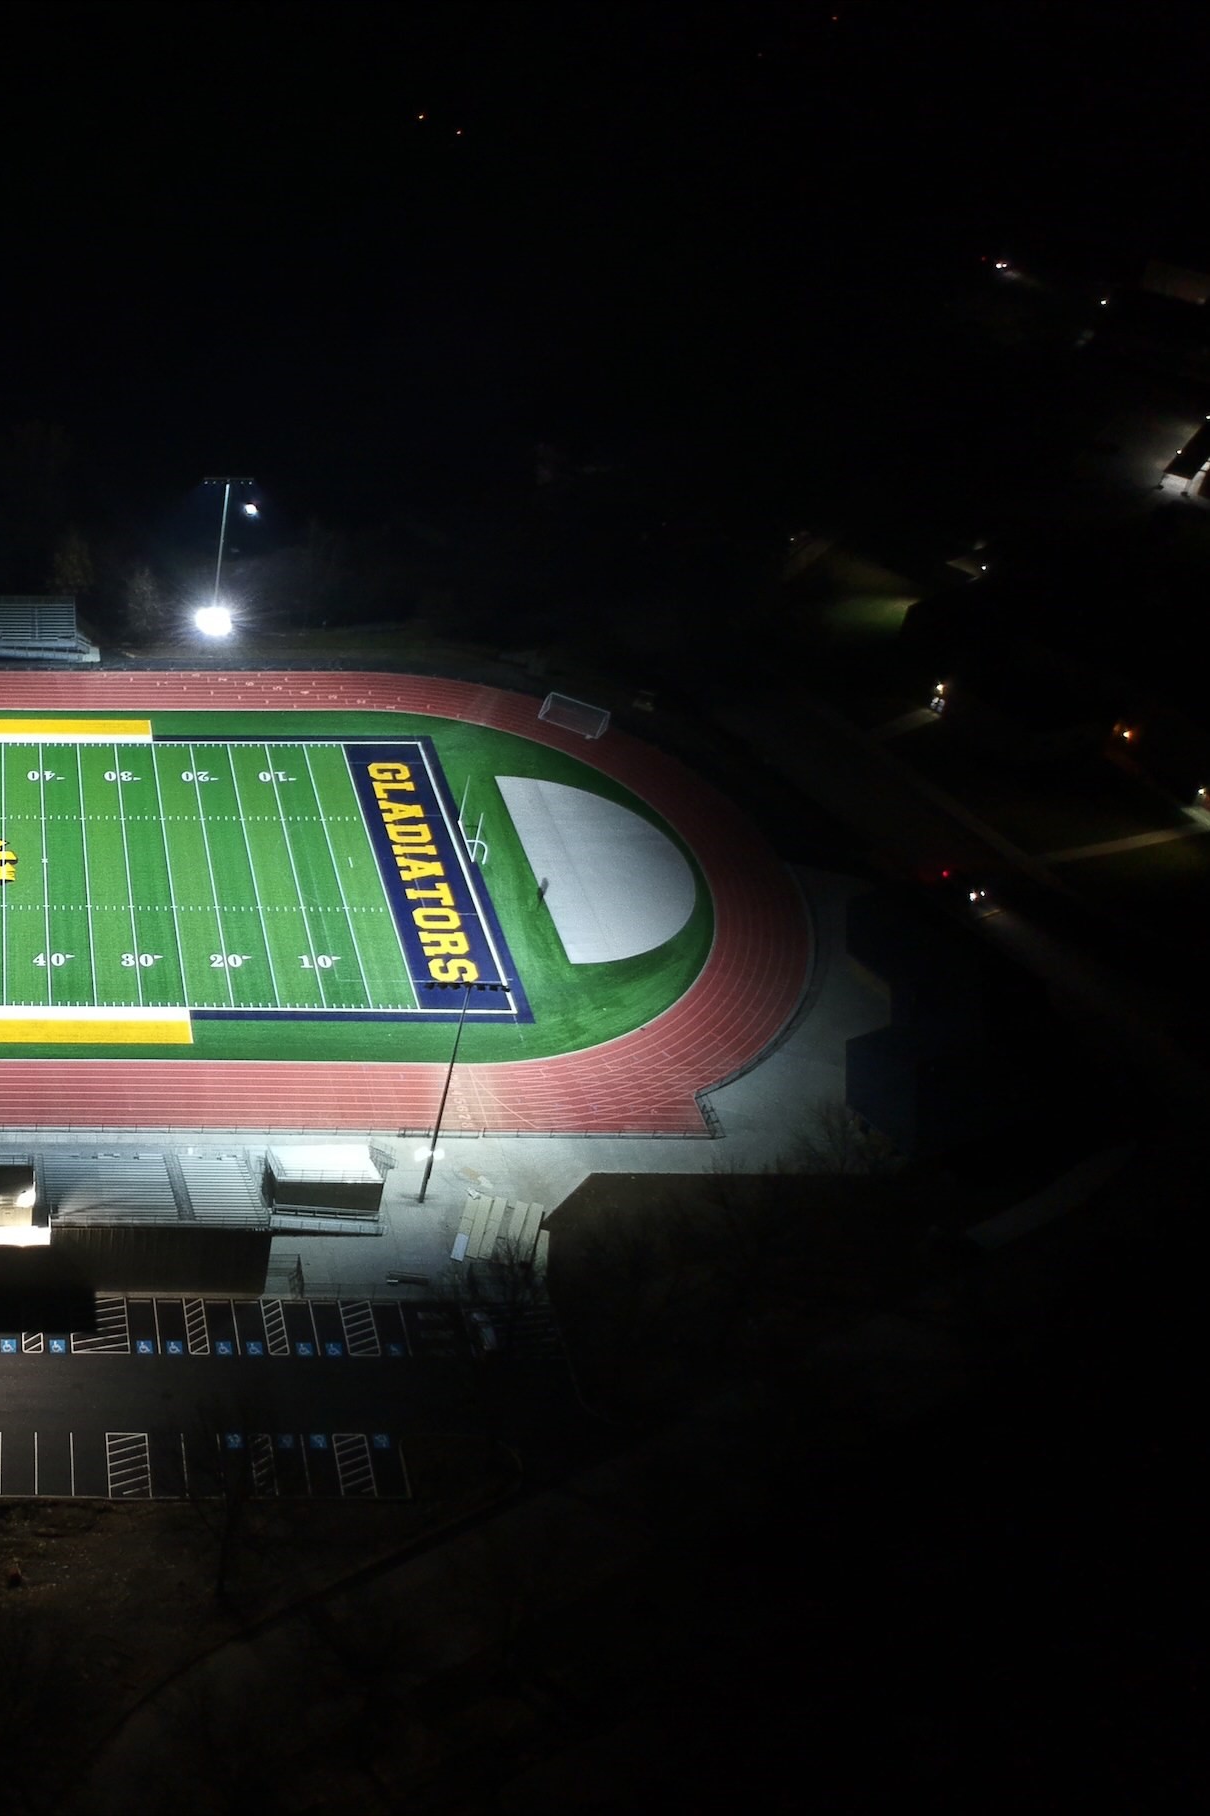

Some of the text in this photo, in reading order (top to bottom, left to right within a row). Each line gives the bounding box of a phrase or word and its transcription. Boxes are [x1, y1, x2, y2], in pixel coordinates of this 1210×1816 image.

[367, 762, 479, 983] GLADIATORS
[32, 952, 66, 967] 40
[120, 953, 154, 968] 30
[209, 954, 243, 968] 20
[298, 954, 333, 969] 10
